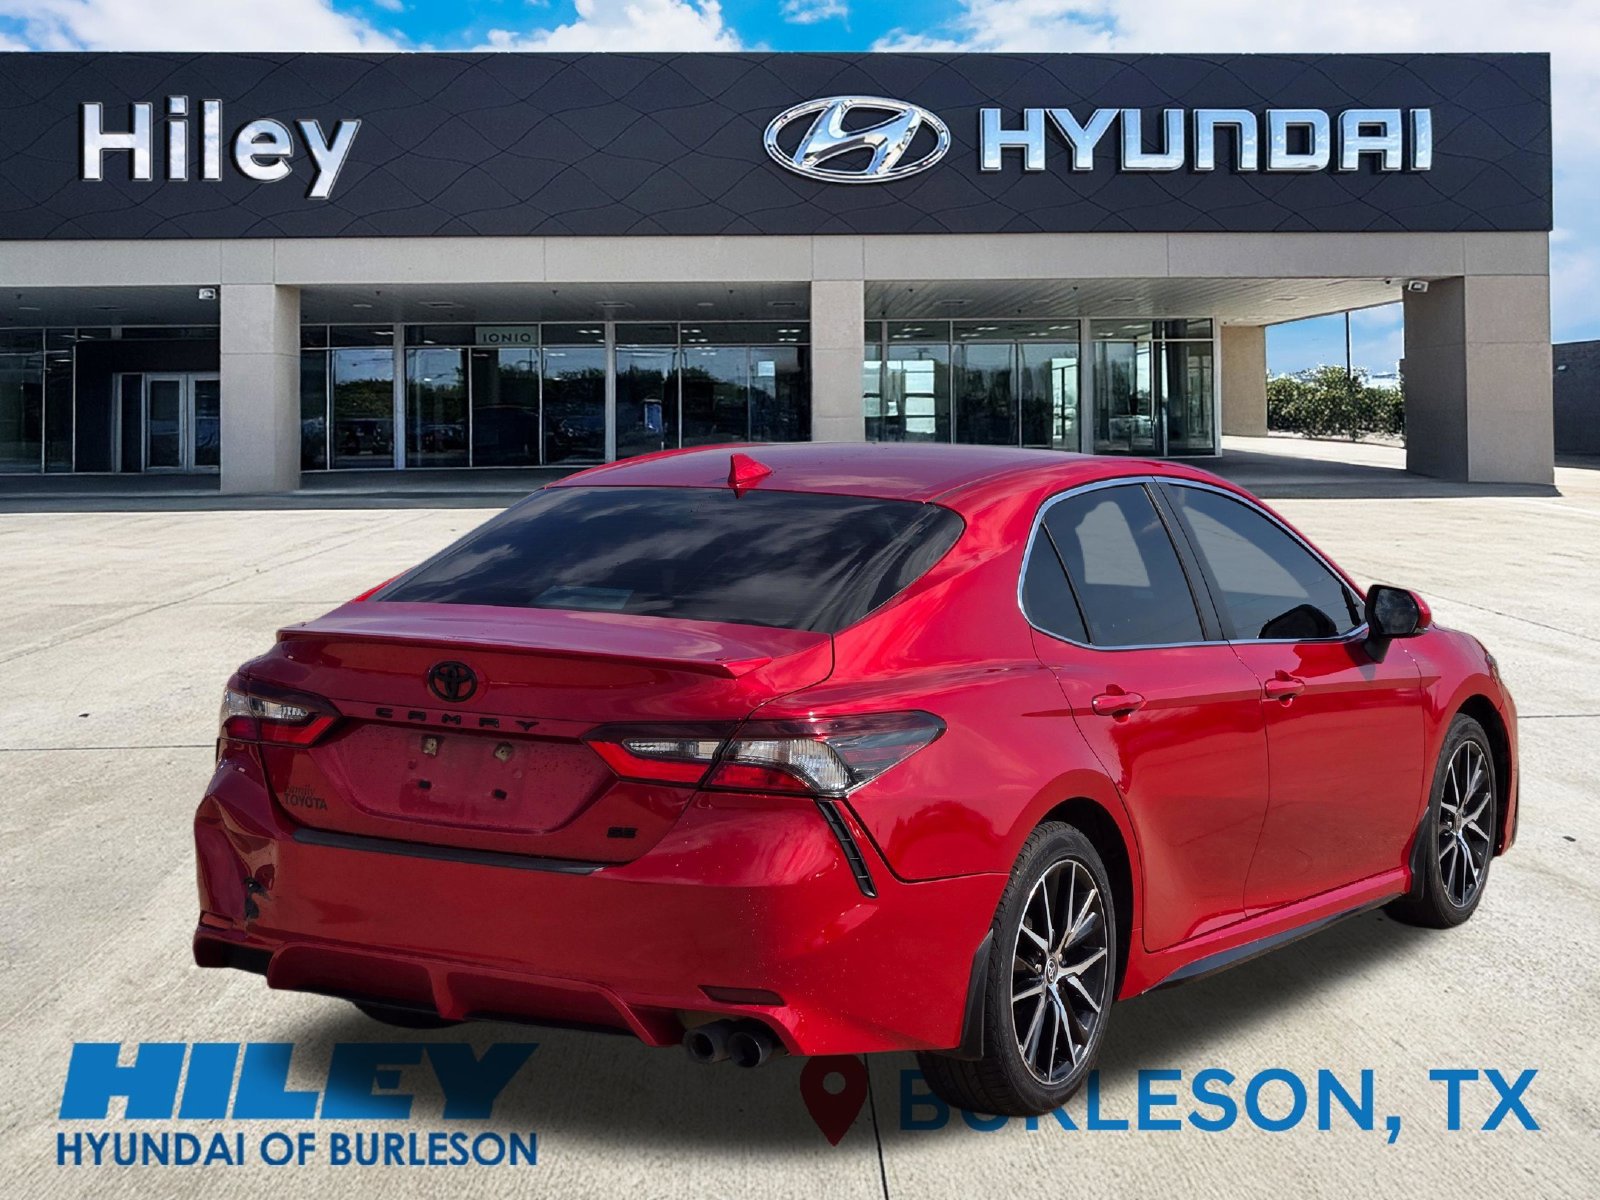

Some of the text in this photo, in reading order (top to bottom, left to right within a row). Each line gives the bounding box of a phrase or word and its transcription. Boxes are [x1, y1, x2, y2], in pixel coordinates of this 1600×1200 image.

[81, 95, 361, 199] Hiley
[979, 107, 1433, 172] HYUNDAI
[375, 707, 540, 731] CAMRY
[284, 792, 328, 811] TOYOTA
